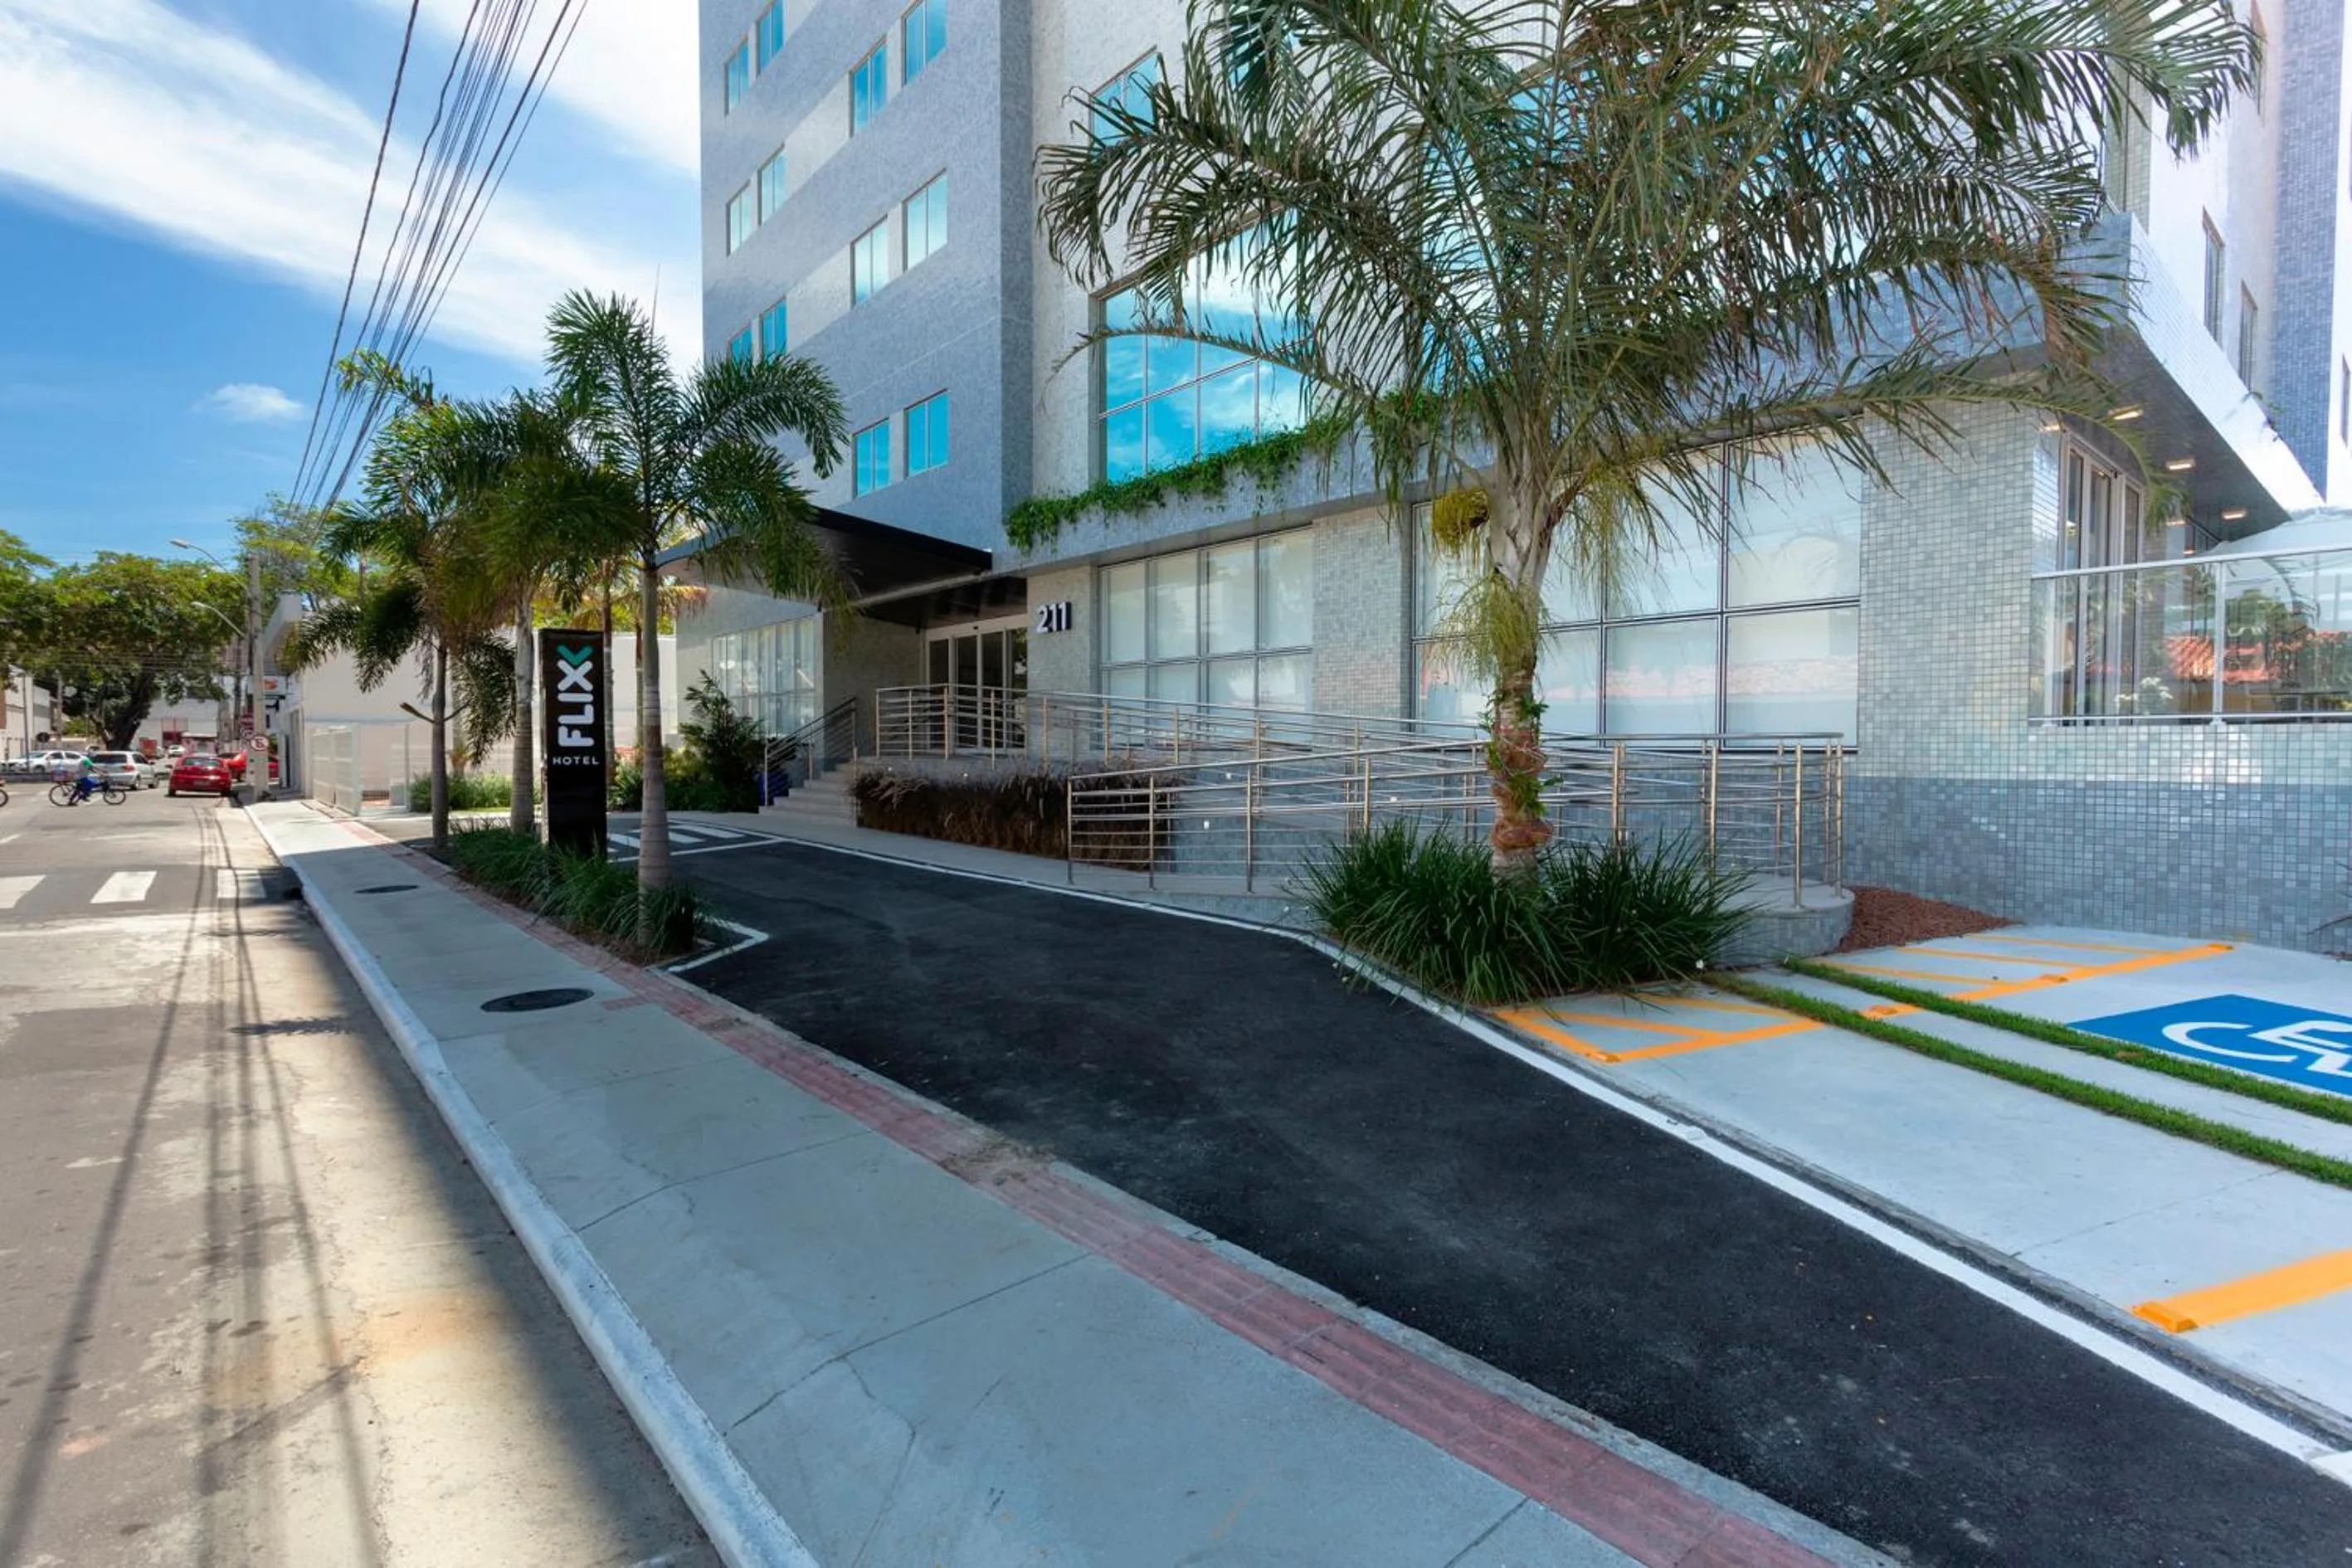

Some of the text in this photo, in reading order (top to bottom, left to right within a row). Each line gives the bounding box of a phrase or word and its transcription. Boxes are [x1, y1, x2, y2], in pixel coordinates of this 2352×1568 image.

[1036, 601, 1069, 633] 211
[557, 658, 595, 747] FLIX
[552, 756, 599, 765] HOTEL
